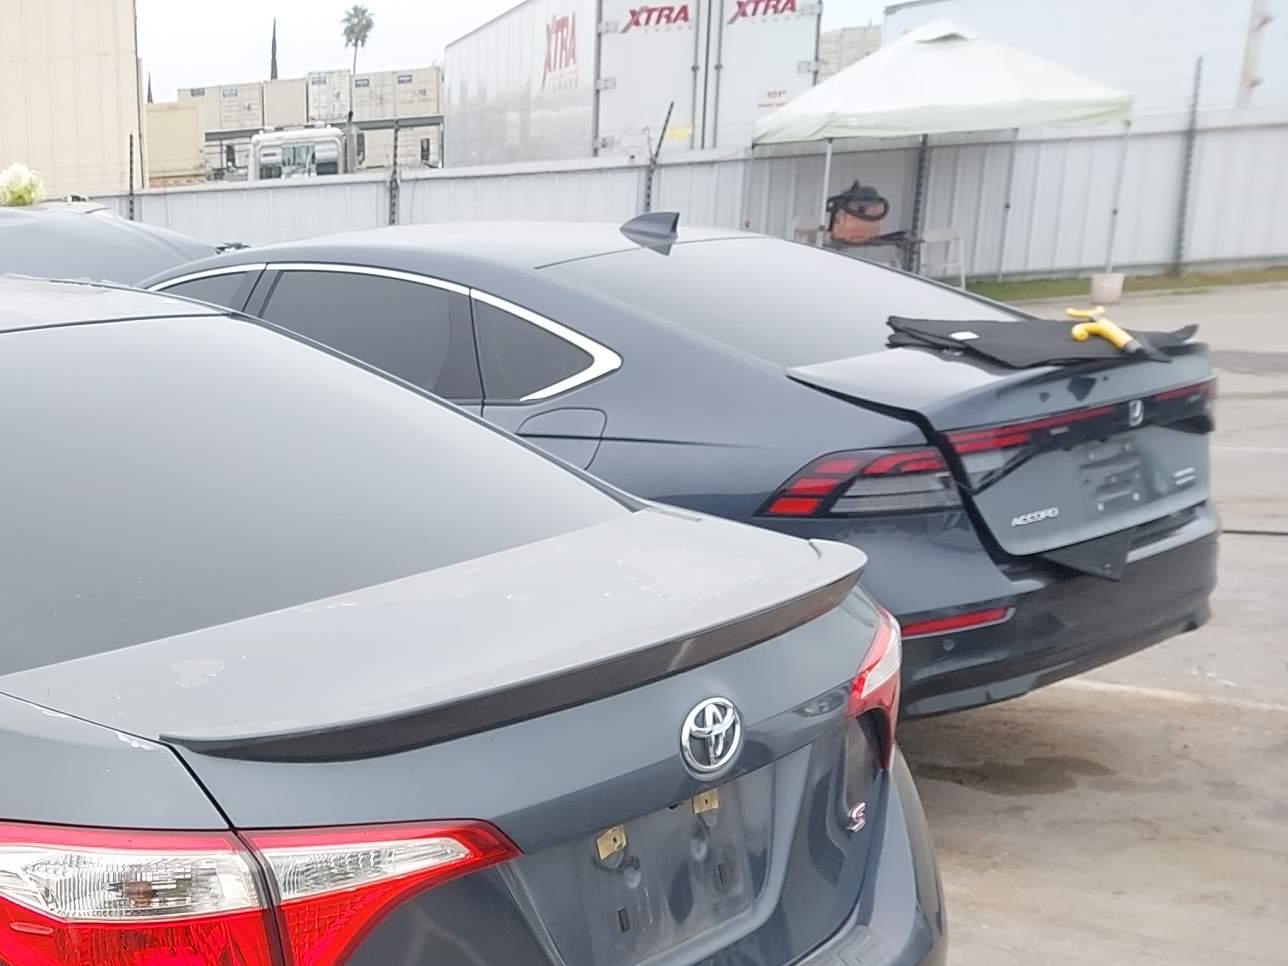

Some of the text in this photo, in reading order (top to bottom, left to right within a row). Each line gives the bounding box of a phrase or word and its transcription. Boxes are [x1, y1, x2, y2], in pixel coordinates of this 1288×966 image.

[620, 5, 689, 33] XTRA
[727, 0, 796, 24] XTRA
[541, 12, 576, 90] XTRA
[1011, 507, 1059, 527] ACCORD
[848, 802, 866, 832] S
